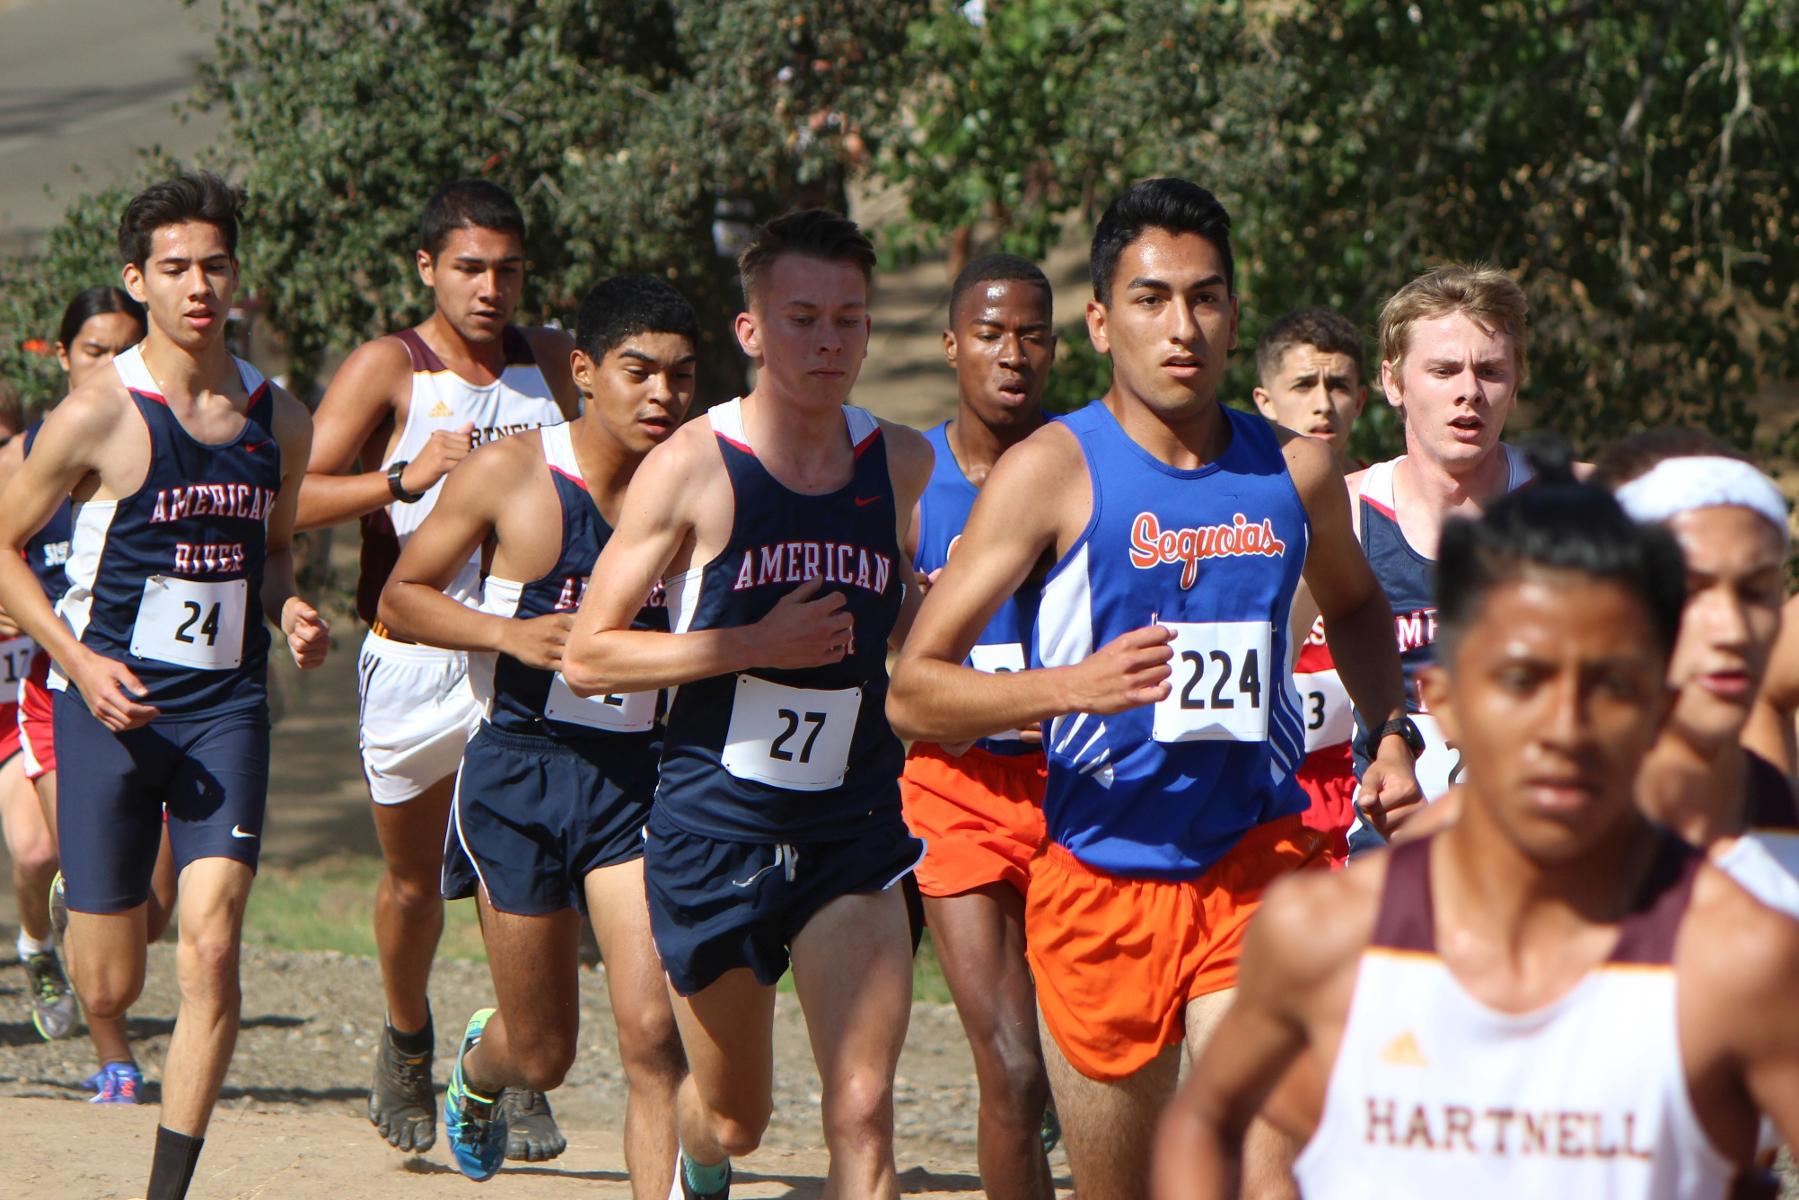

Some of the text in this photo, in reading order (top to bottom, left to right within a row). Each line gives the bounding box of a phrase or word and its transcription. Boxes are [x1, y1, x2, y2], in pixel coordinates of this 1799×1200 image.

[149, 482, 276, 524] AMERICAN
[172, 542, 245, 574] RIVER
[733, 542, 891, 595] AMERICAN
[1129, 512, 1286, 590] Sequoias
[174, 601, 221, 646] 24
[1180, 649, 1261, 709] 224
[769, 709, 827, 763] 27
[1363, 1096, 1651, 1161] HARTNELL
